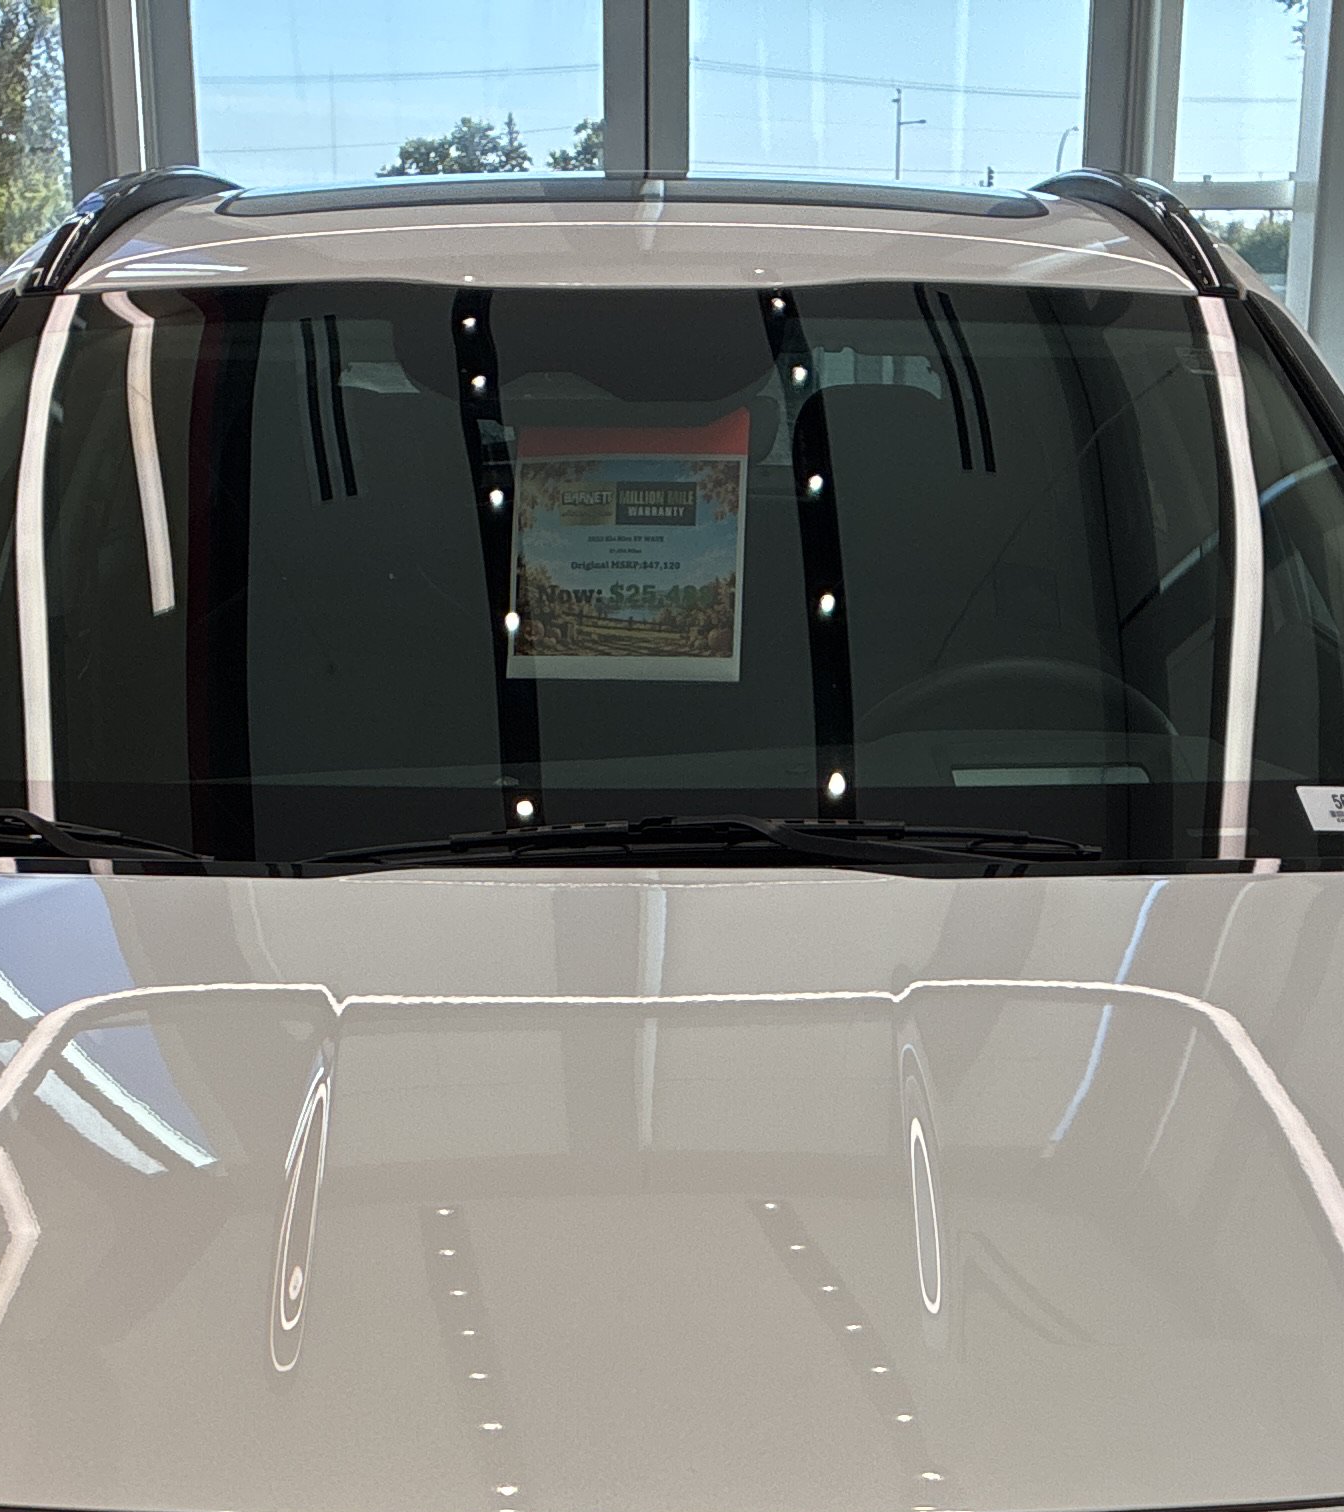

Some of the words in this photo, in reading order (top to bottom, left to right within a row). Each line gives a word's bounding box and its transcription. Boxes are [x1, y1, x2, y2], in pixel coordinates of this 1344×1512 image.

[619, 490, 664, 505] MILLION
[628, 506, 685, 517] WARRANTY
[571, 561, 609, 571] Original
[538, 584, 603, 604] Now:
